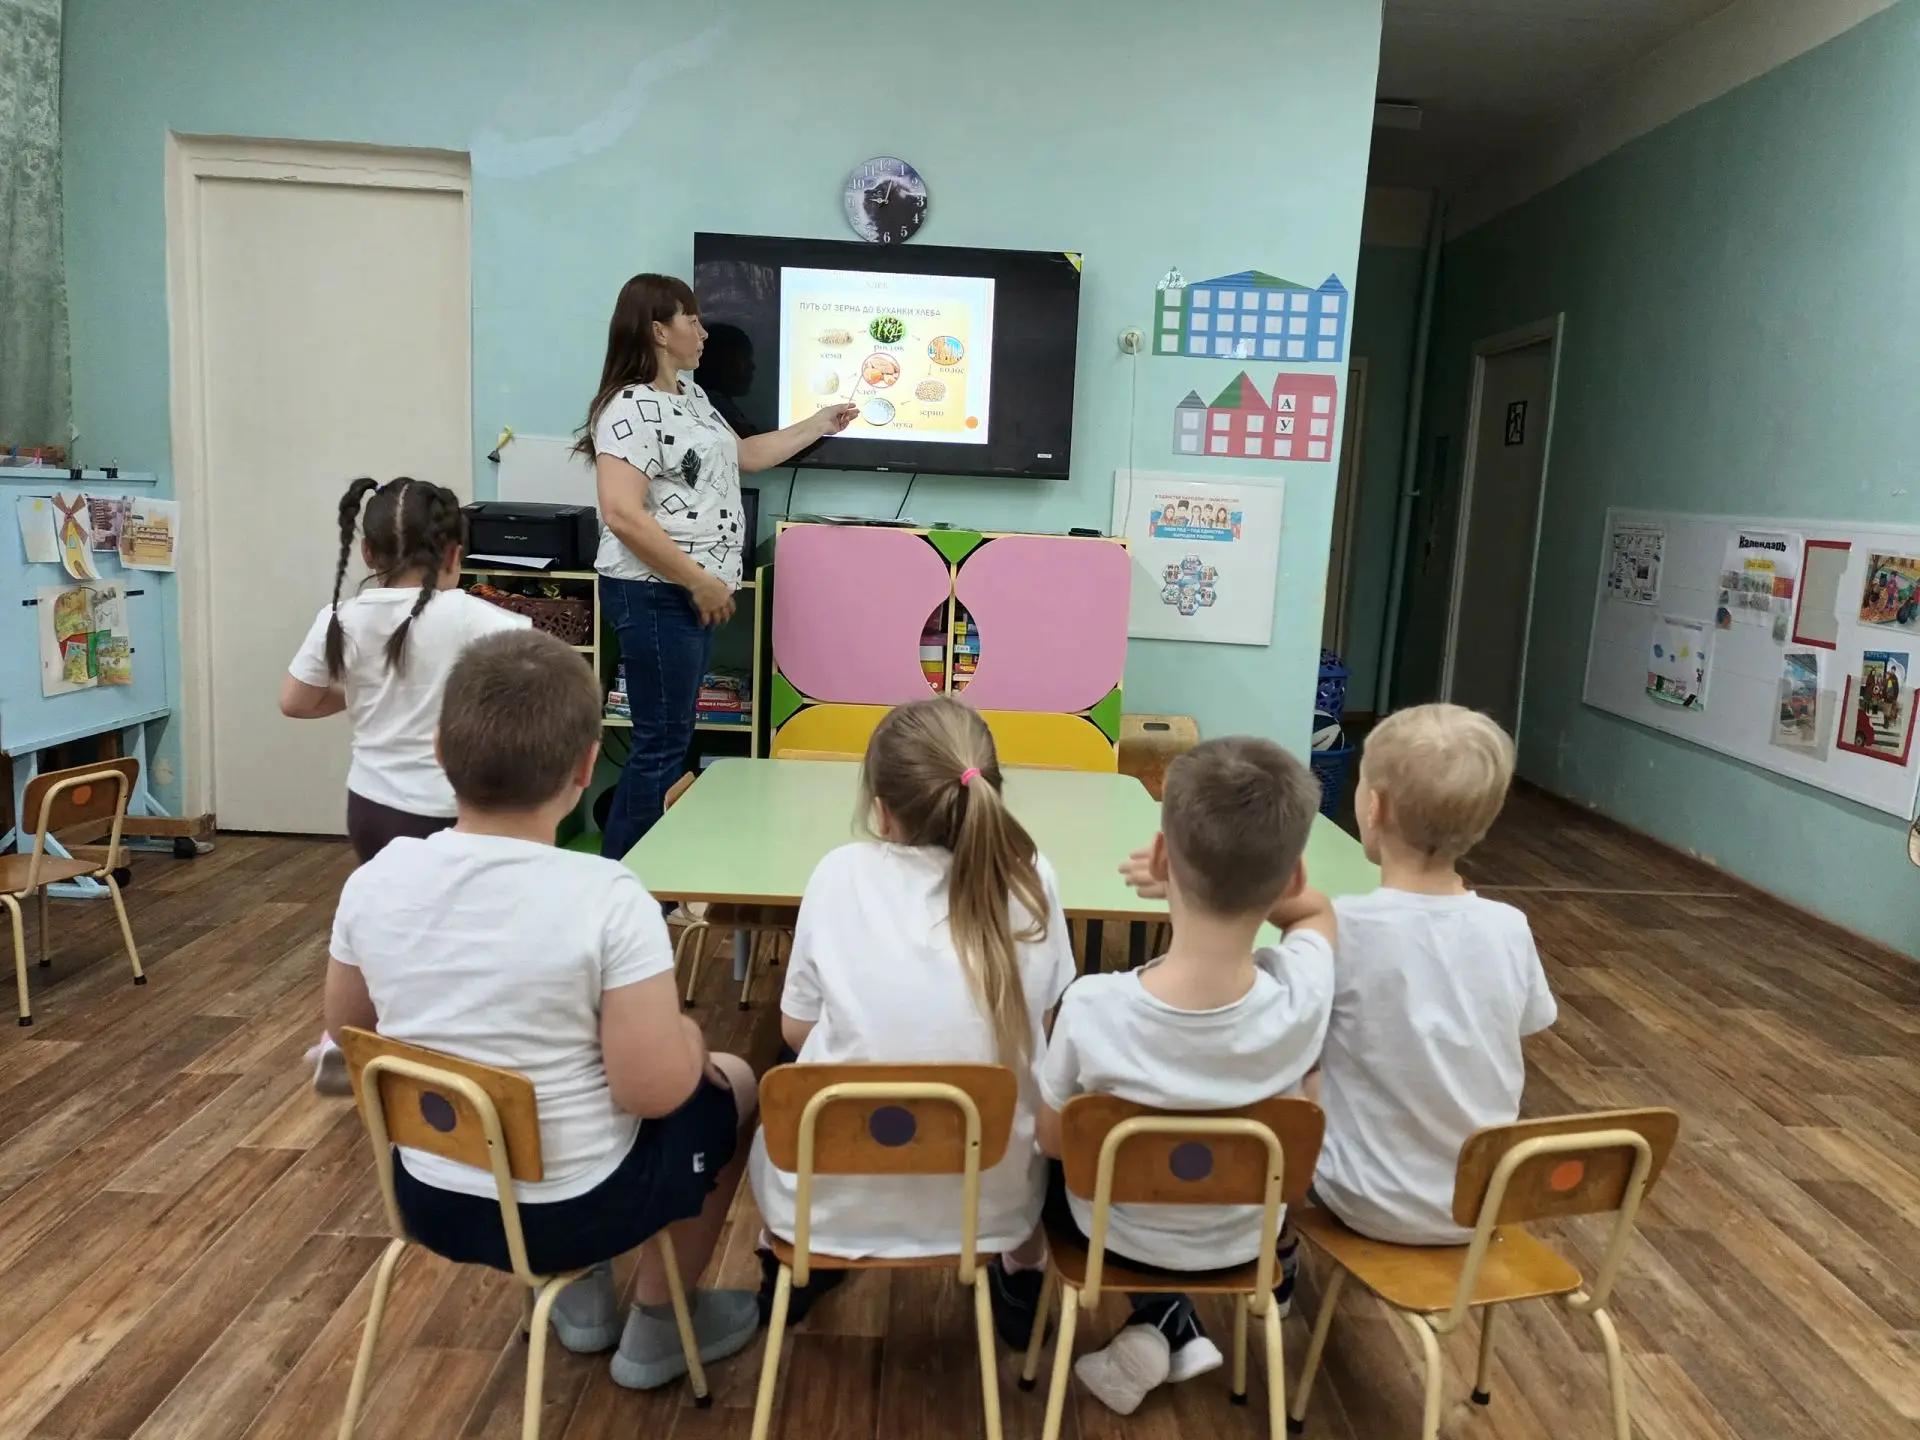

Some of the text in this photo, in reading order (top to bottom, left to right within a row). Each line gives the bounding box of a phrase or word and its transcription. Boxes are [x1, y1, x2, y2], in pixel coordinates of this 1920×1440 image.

[864, 165, 875, 177] 11
[880, 159, 891, 171] 12
[852, 177, 865, 190] 10
[912, 177, 918, 189] 2
[917, 196, 924, 207] 3
[912, 213, 919, 224] 4
[883, 231, 891, 243] 6
[900, 225, 908, 237] 5
[800, 302, 820, 311] ПУТЬ
[822, 303, 831, 311] ОТ
[834, 304, 860, 313] ЗЕРНА
[862, 305, 874, 314] ДО
[876, 306, 913, 315] БУХАНКИ
[939, 367, 965, 375] колос
[1281, 399, 1291, 409] А
[919, 410, 944, 418] зерно
[1280, 419, 1291, 431] У
[1738, 535, 1787, 552] Календарь
